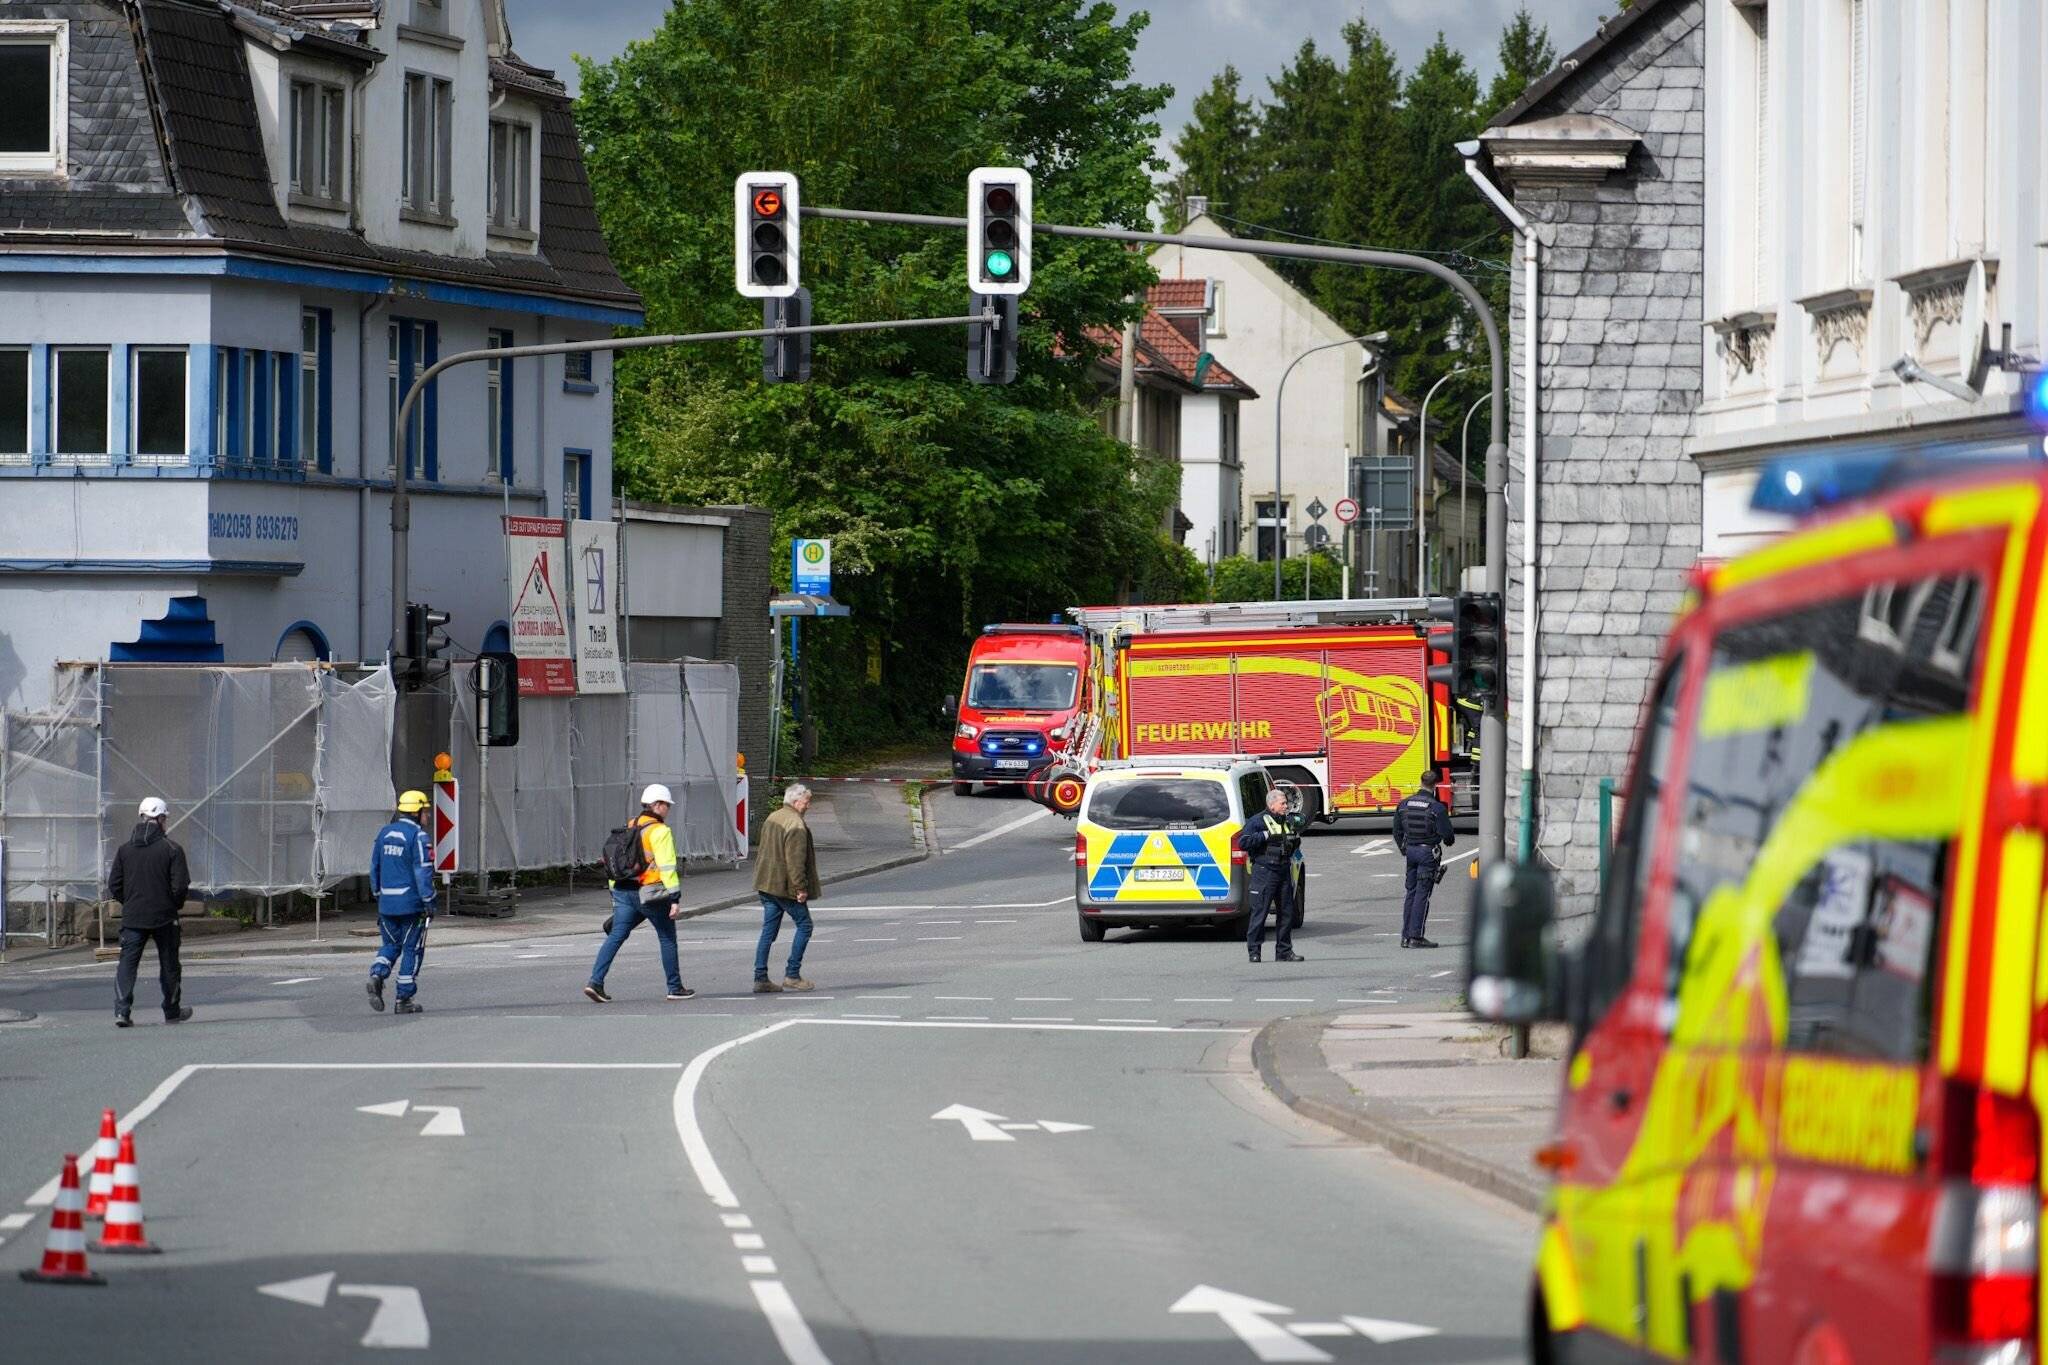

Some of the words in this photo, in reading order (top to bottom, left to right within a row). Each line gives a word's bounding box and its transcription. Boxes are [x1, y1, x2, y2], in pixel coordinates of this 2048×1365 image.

[256, 515, 298, 540] 8936279
[1135, 720, 1272, 743] FEUERWEHR
[383, 844, 405, 857] THW
